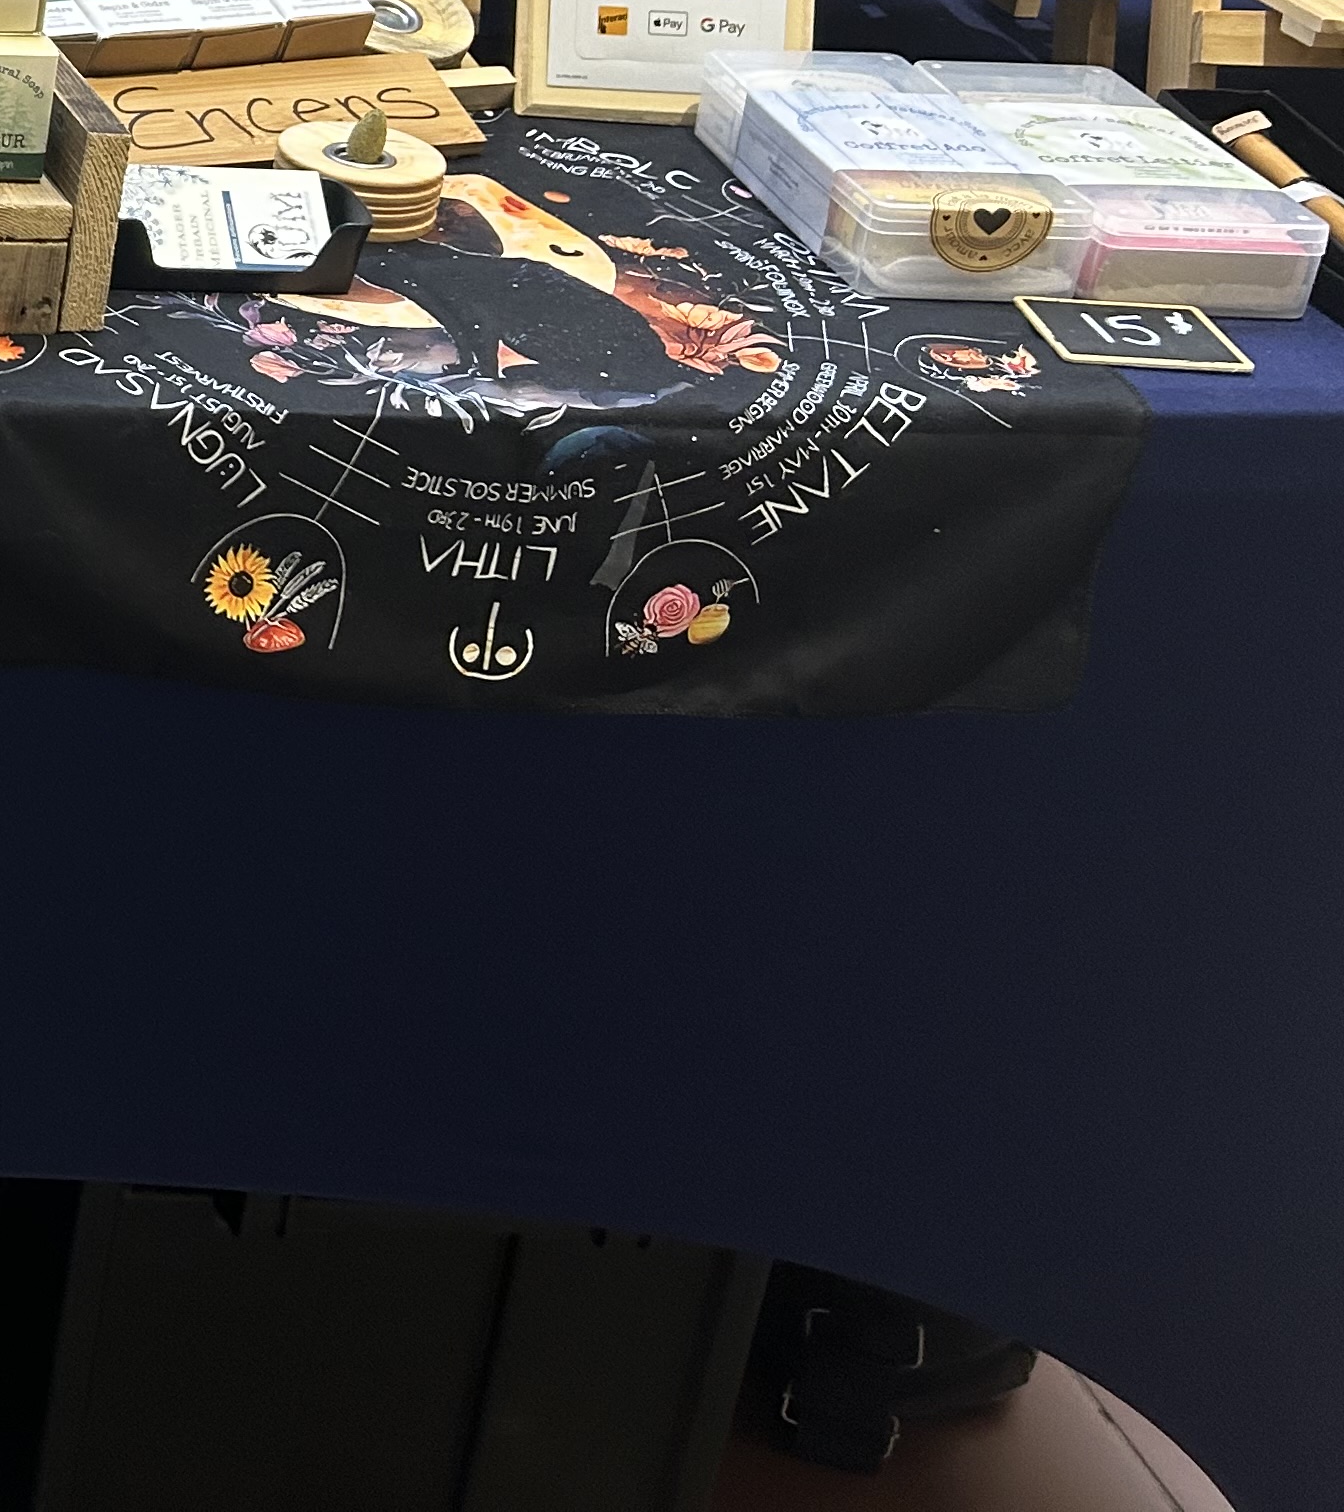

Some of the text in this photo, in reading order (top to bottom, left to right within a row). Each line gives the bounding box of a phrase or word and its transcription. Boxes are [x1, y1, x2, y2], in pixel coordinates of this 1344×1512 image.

[22, 74, 44, 100] Soap
[113, 86, 440, 150] Encens
[420, 534, 558, 582] LITHA
